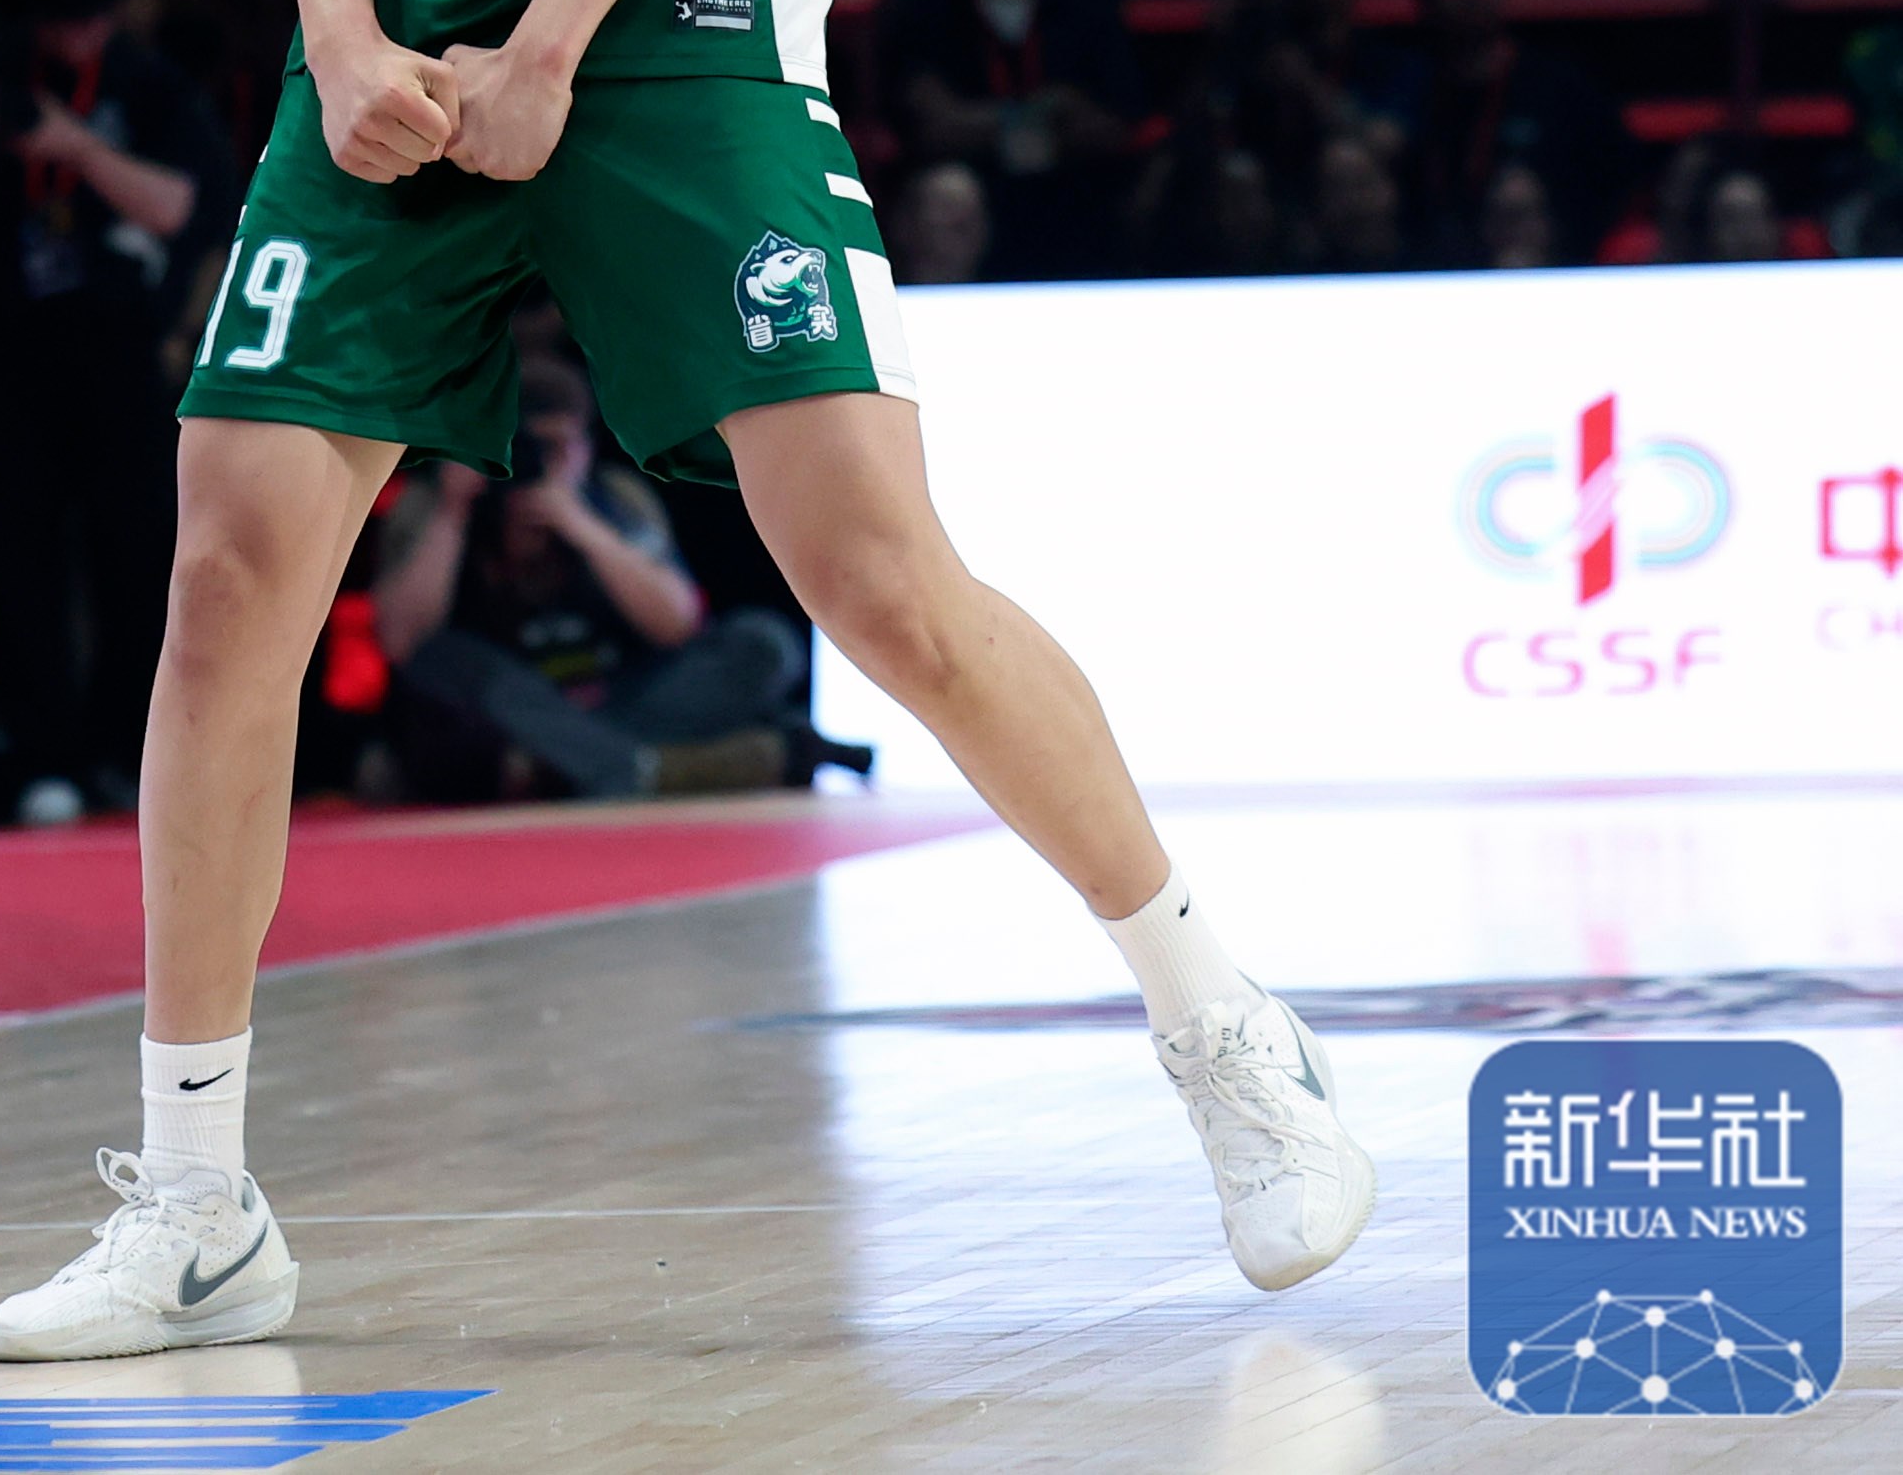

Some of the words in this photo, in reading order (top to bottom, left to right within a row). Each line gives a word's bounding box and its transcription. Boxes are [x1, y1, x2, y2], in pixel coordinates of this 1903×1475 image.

[196, 238, 311, 371] 19
[746, 303, 835, 348] 省实
[1461, 628, 1723, 698] CSSF
